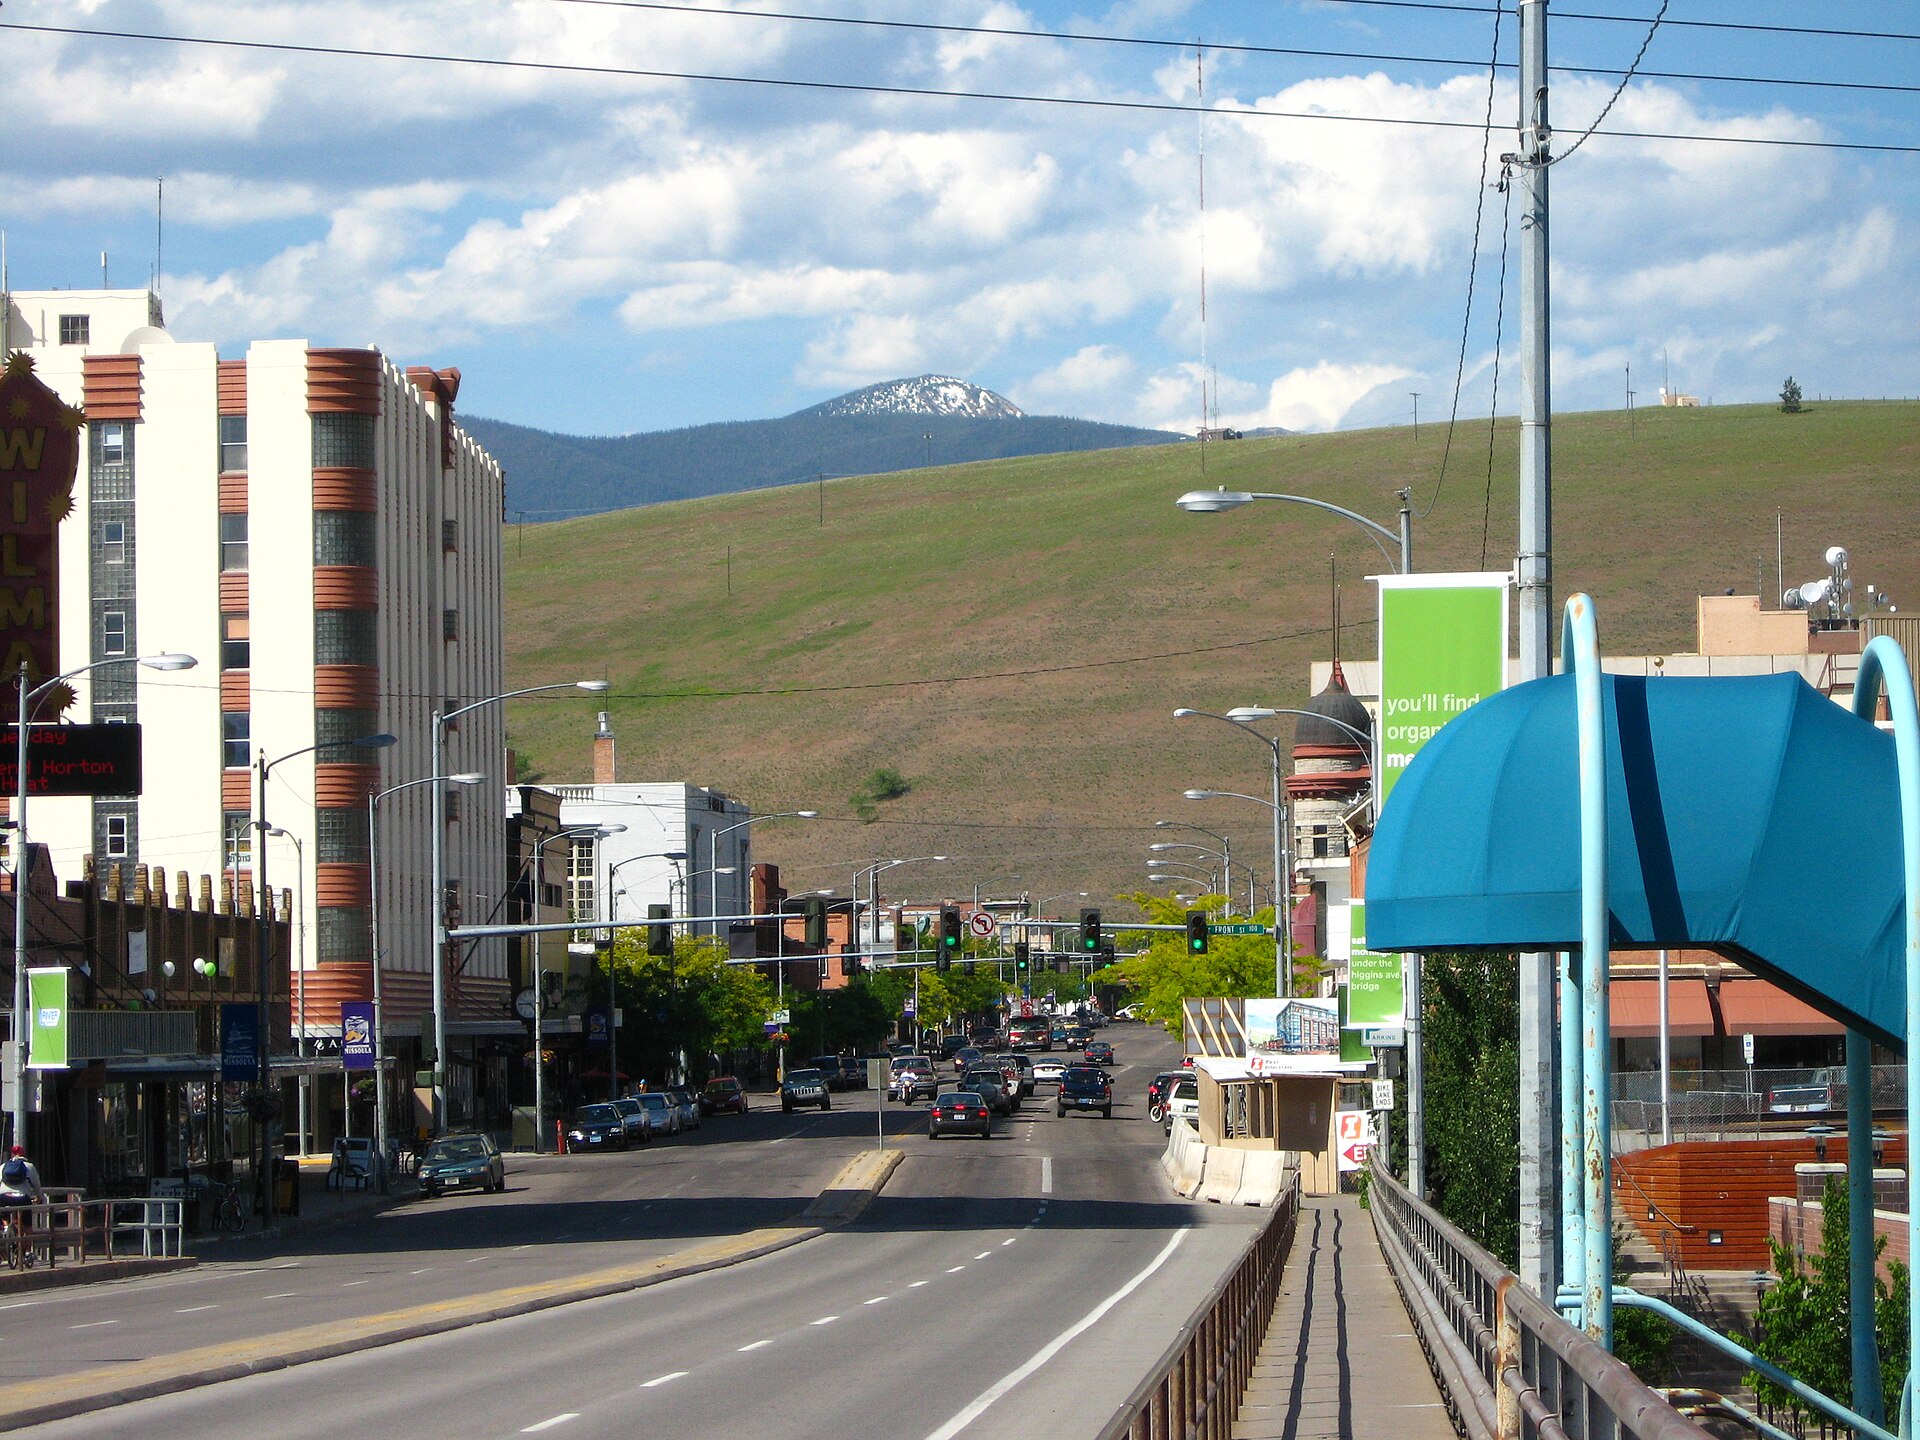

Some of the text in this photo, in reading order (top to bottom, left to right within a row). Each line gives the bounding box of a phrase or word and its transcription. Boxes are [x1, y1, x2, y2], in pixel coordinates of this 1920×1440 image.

[0, 427, 47, 684] WILMA
[1386, 693, 1480, 716] you'll find
[0, 730, 68, 745] ueday
[1386, 721, 1448, 744] organ
[43, 759, 116, 776] Horton
[1, 776, 49, 791] Hat
[1214, 925, 1234, 934] FRONT
[1351, 959, 1393, 967] under the
[1351, 971, 1384, 981] higgins
[1351, 982, 1380, 992] bridge
[343, 1047, 372, 1055] MISSOULA
